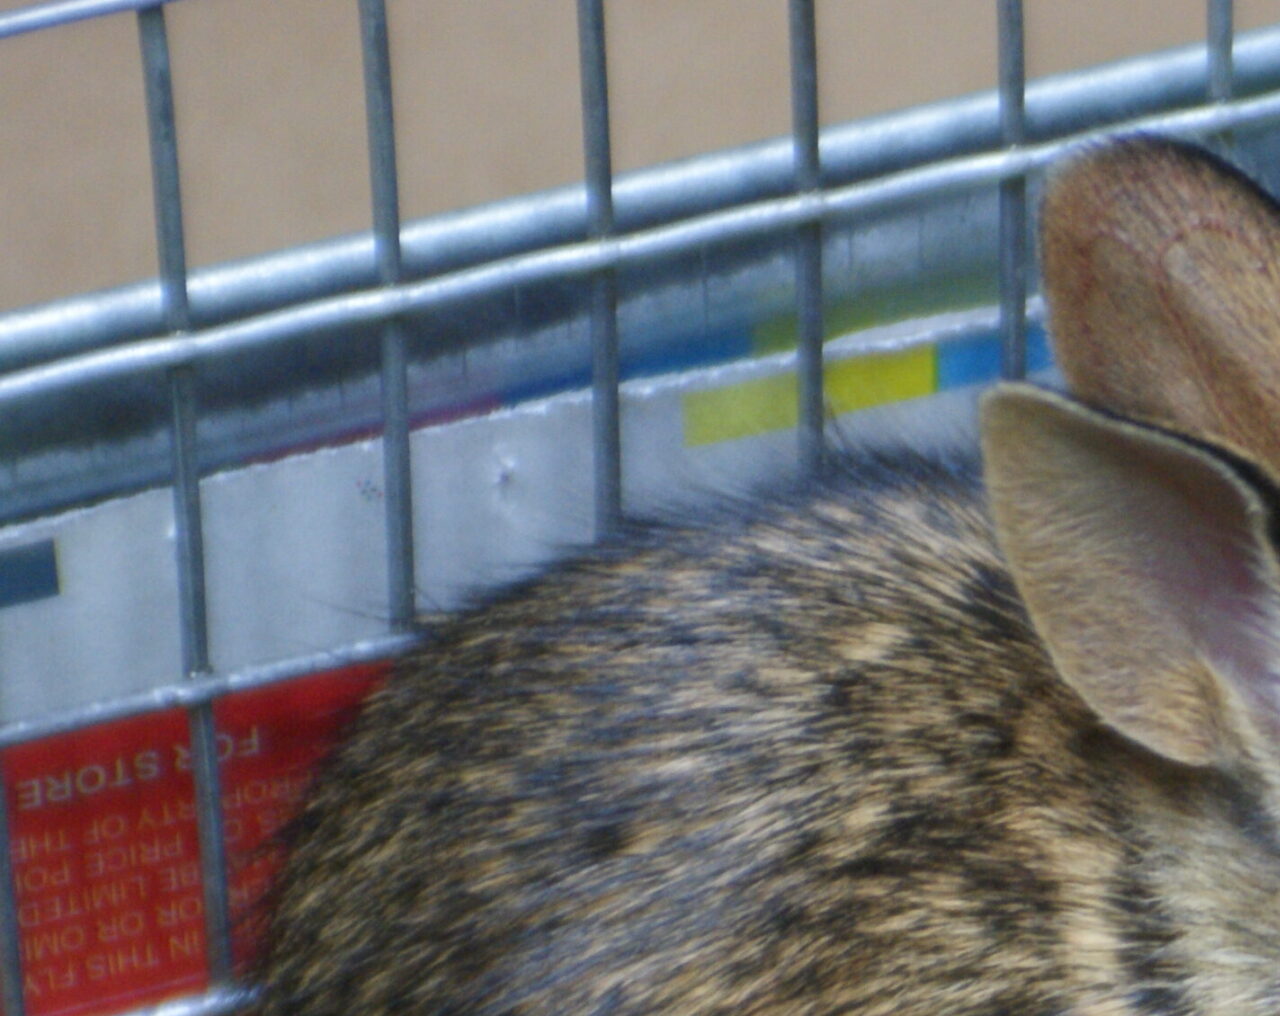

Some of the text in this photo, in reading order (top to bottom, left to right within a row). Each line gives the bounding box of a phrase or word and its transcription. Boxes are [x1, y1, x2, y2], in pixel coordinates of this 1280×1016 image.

[17, 725, 260, 811] FOR STORE
[137, 770, 313, 833] PROPRTY
[83, 814, 125, 845] OF
[14, 859, 70, 894] POI
[85, 834, 181, 878] PRICE
[18, 874, 146, 928] LIMITED
[20, 925, 84, 962] OMI
[98, 910, 144, 942] OR
[22, 929, 199, 997] IN THIS FLY
